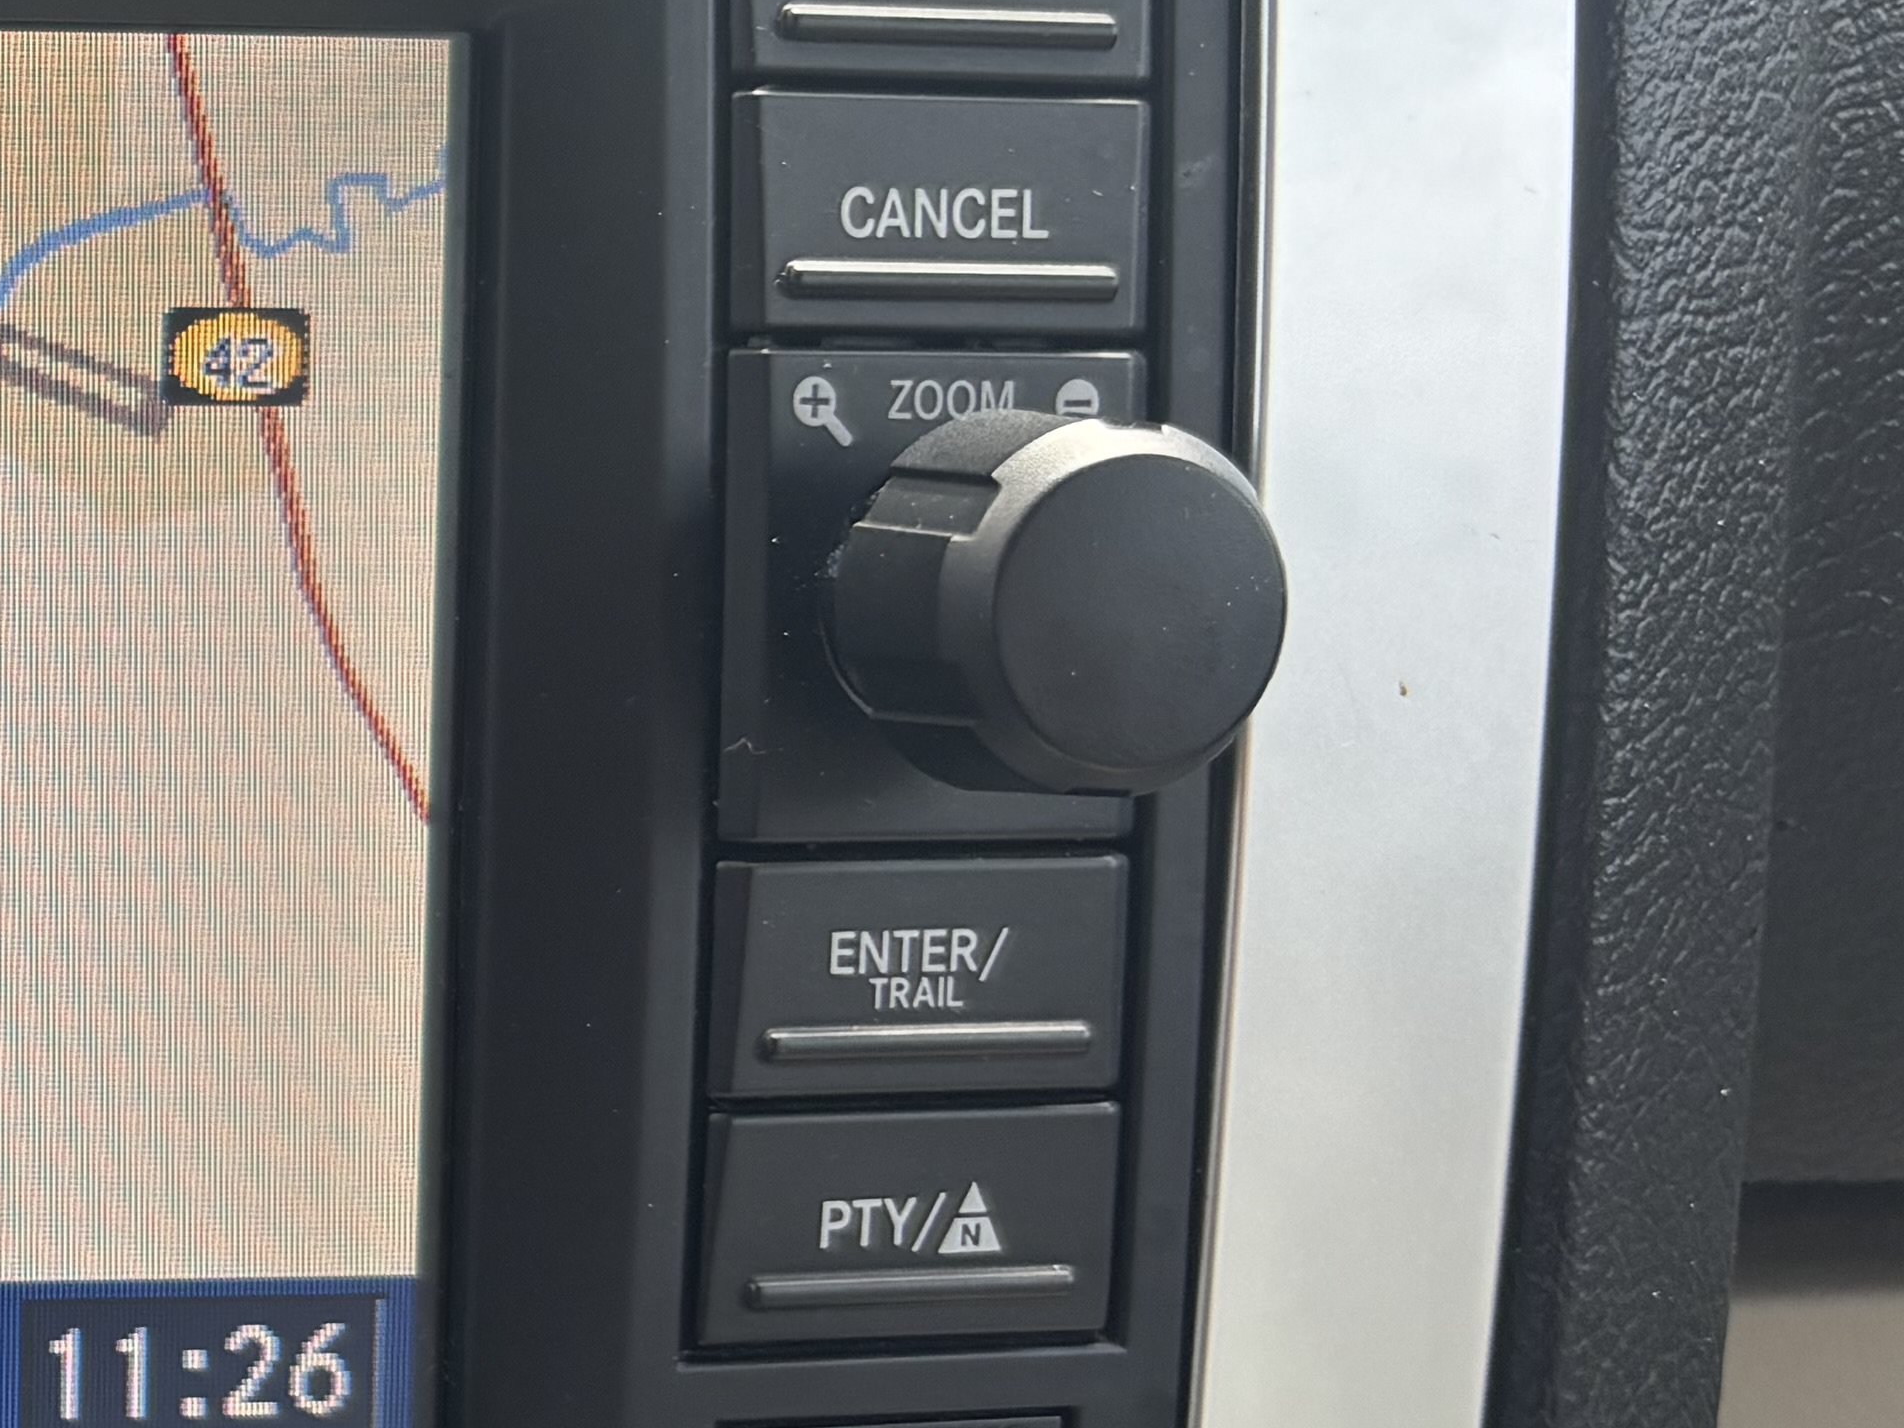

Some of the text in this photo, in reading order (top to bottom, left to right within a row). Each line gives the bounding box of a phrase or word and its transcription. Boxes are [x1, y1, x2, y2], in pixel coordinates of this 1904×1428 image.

[840, 185, 1050, 240] CANCEL
[204, 337, 273, 388] 42
[888, 378, 1015, 421] ZOOM
[828, 927, 1009, 982] ENTER/
[869, 976, 964, 1010] TRAIL
[48, 1322, 351, 1422] 11:26
